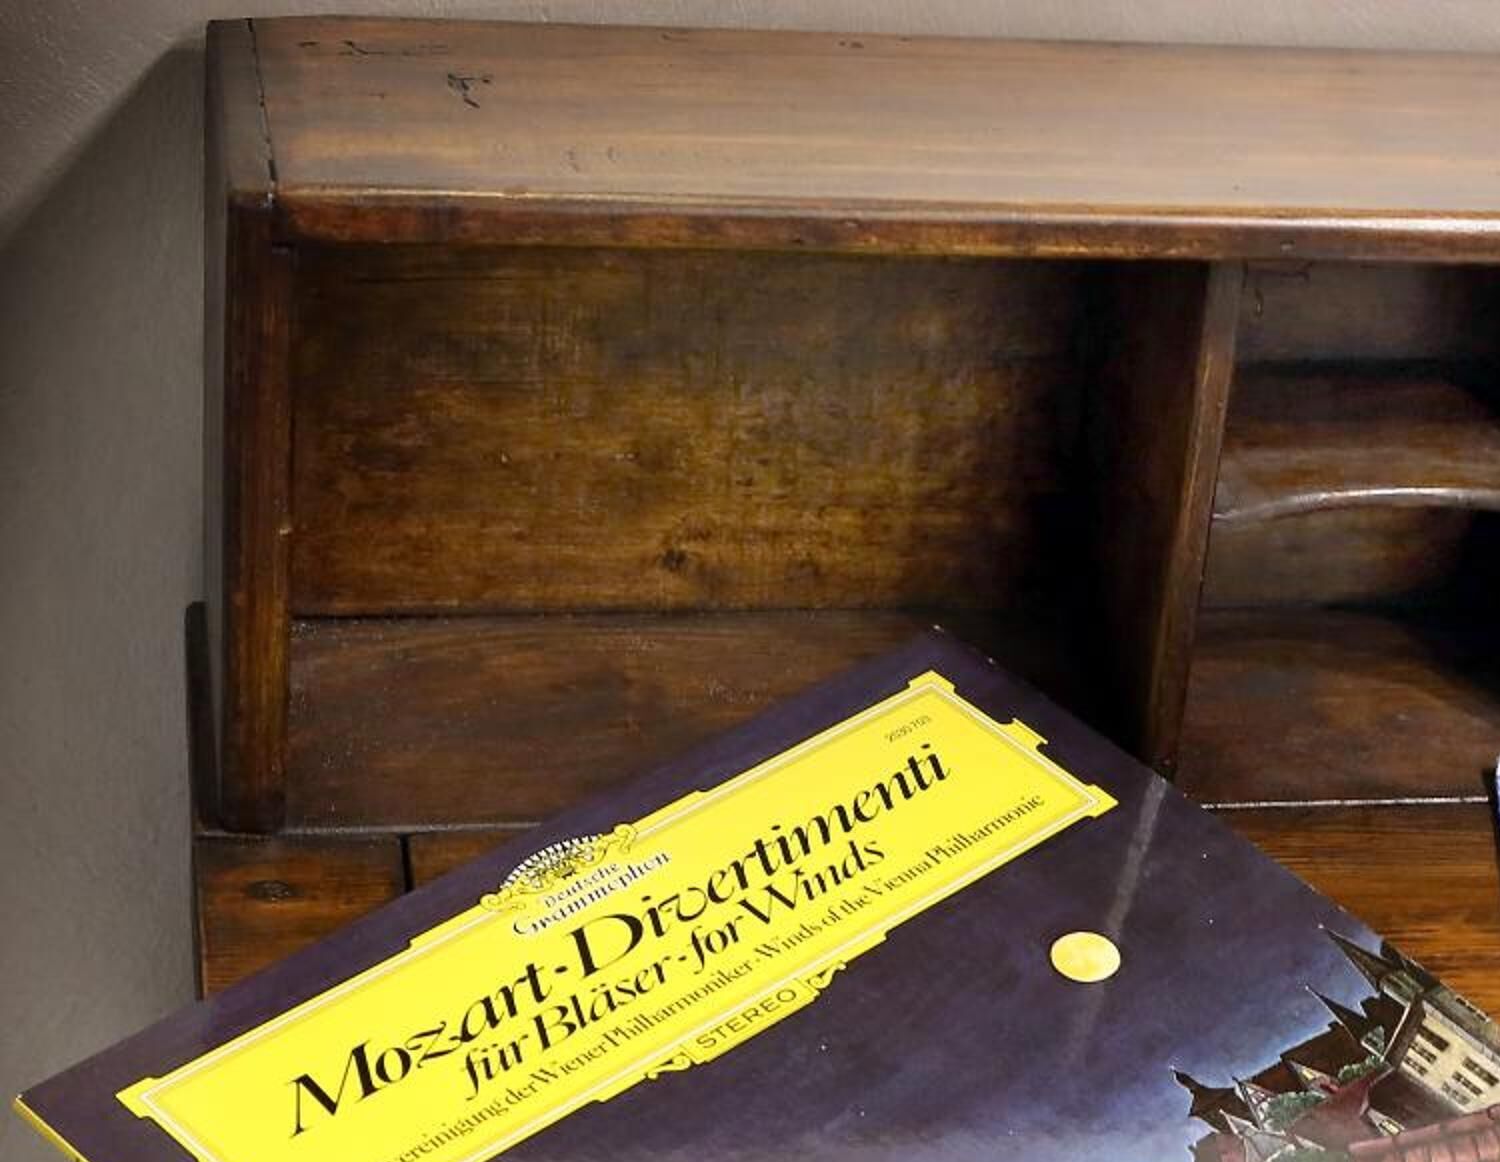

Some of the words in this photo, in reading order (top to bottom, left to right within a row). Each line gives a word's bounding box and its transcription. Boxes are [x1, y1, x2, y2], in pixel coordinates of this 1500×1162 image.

[289, 963, 553, 1138] Mozart
[566, 743, 951, 978] Divertimenti
[463, 1032, 530, 1100] für
[530, 954, 672, 1051] Bläser
[692, 913, 747, 974] for
[736, 838, 886, 926] Winds
[504, 1081, 538, 1105] der
[529, 1041, 609, 1084] Wiener
[602, 961, 753, 1048] Philharmoniker
[754, 924, 823, 957] Winds
[821, 907, 842, 926] of
[840, 895, 873, 914] the
[864, 861, 932, 895] Vienna
[927, 793, 1045, 865] Philharmonic
[543, 862, 621, 908] Deutsche
[696, 988, 797, 1050] STEREO
